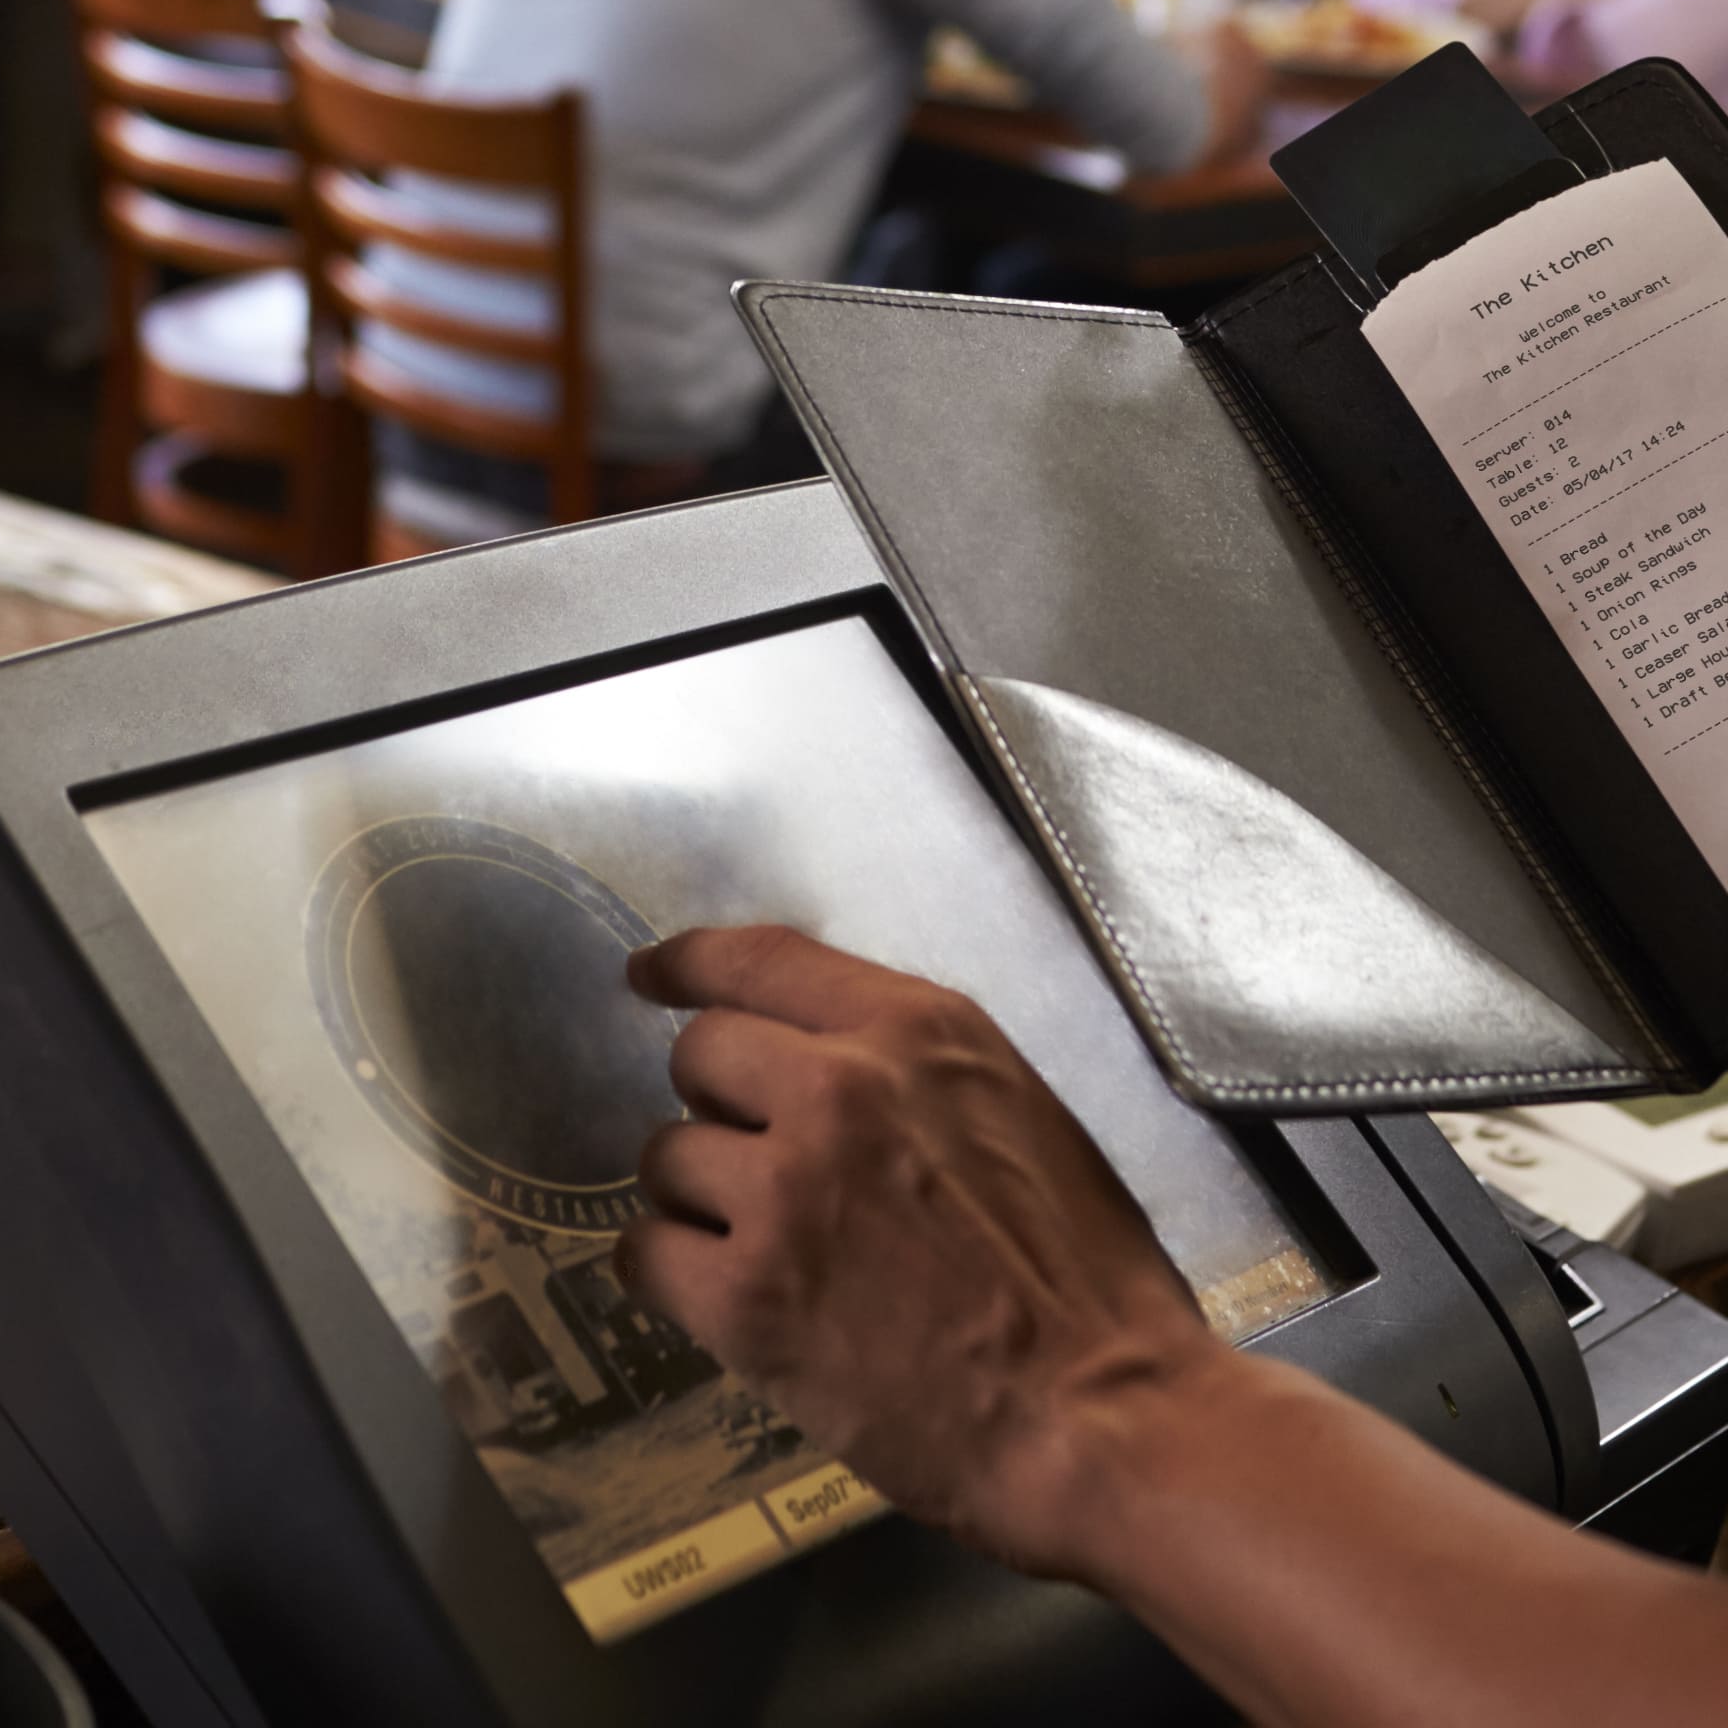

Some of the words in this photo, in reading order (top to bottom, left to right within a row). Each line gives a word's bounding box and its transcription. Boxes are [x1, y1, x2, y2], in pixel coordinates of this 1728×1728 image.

[1470, 291, 1513, 320] The
[1520, 235, 1614, 292] Kitchen
[1482, 364, 1511, 384] The
[1516, 324, 1580, 366] Kitchen
[1583, 275, 1671, 326] Restaurant
[1519, 303, 1581, 343] Welcome
[1588, 289, 1607, 303] to
[1475, 431, 1535, 472] Server:
[1543, 409, 1572, 431] 014
[1486, 454, 1539, 489] Table:
[1548, 437, 1569, 454] 12
[1498, 467, 1559, 508] Guests:
[1568, 455, 1581, 468] 2
[1510, 496, 1554, 527] Date:
[1562, 448, 1633, 496] 05/04/17
[1640, 421, 1686, 452] 14:24
[1543, 563, 1554, 575] 1
[1559, 532, 1609, 566] Bread
[1556, 582, 1566, 594] 1
[1572, 557, 1610, 584] Soup
[1618, 541, 1636, 559] of
[1644, 523, 1672, 543] the
[1676, 502, 1707, 525] Day
[1568, 601, 1578, 612] 1
[1584, 571, 1633, 603] Steak
[1638, 526, 1712, 573] Sandwich
[1580, 620, 1590, 632] 1
[1597, 590, 1646, 621] Onion
[1649, 560, 1697, 592] Rings
[1593, 639, 1603, 651] 1
[1609, 614, 1649, 641] Cola
[1605, 658, 1615, 670] 1
[1622, 623, 1680, 660] Garlic
[1618, 677, 1628, 689] 1
[1634, 642, 1690, 679] Ceaser
[1630, 696, 1641, 708] 1
[1646, 668, 1696, 699] Large
[1643, 716, 1653, 728] 1
[1659, 685, 1708, 719] Draft
